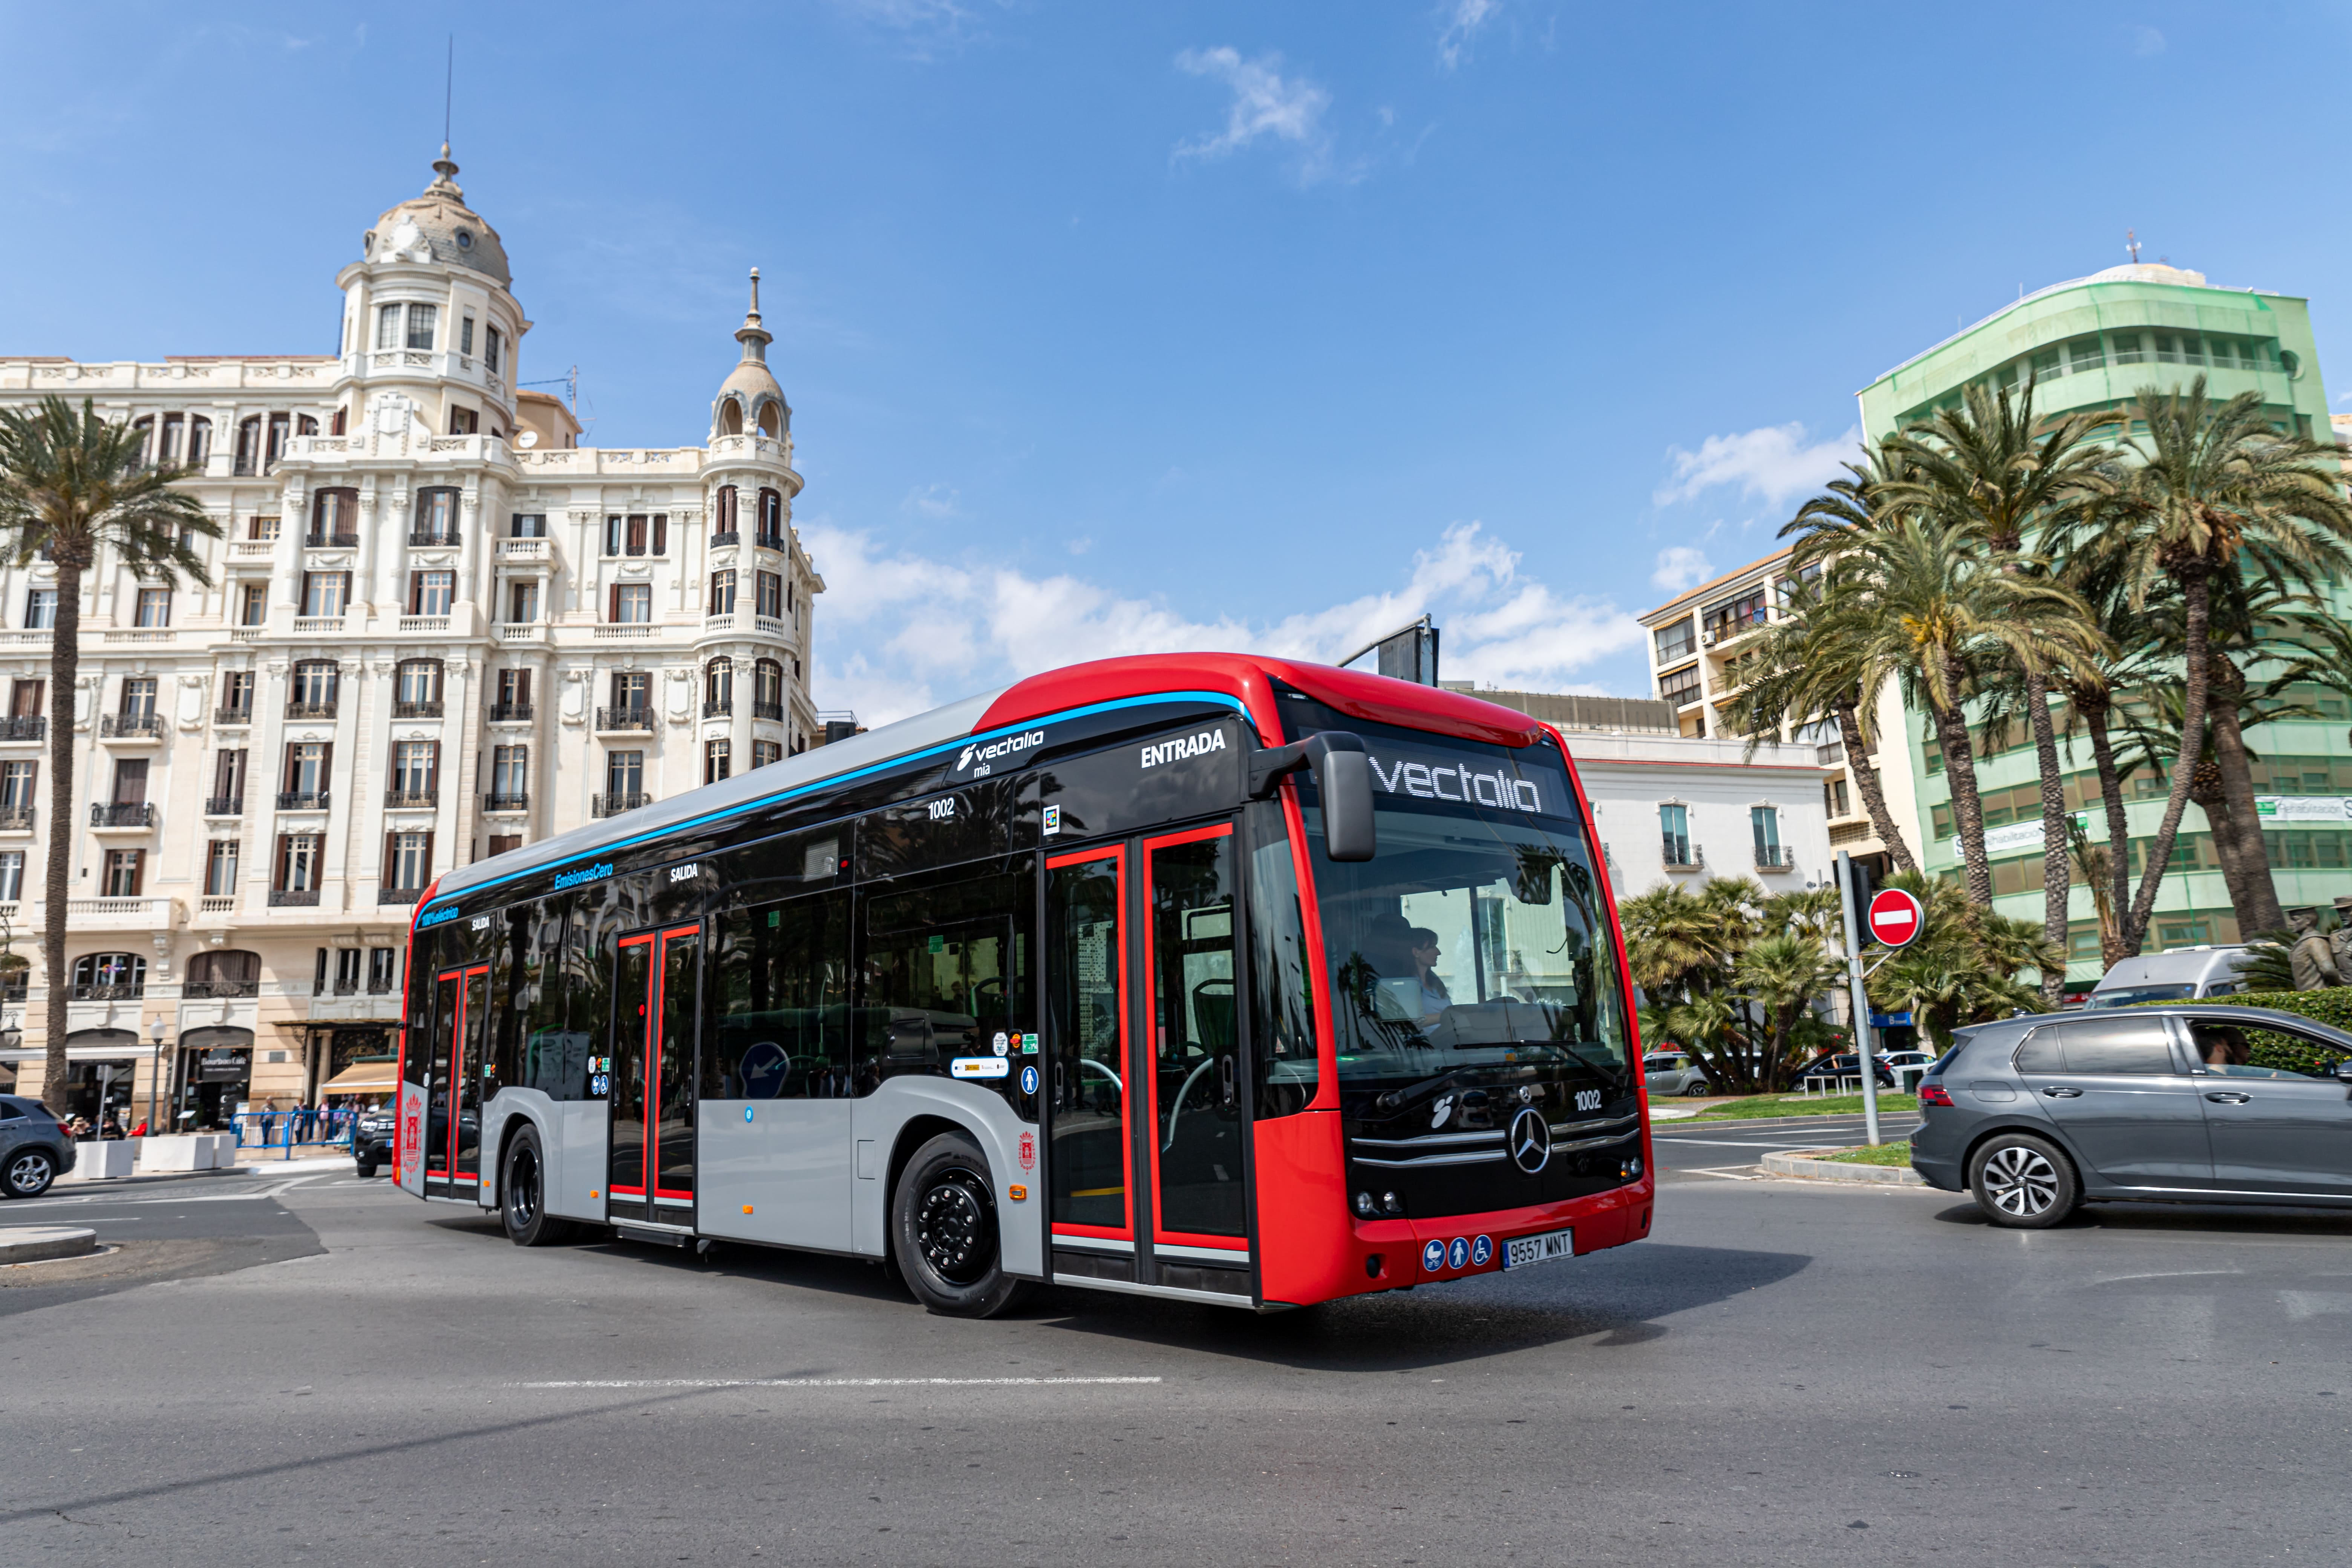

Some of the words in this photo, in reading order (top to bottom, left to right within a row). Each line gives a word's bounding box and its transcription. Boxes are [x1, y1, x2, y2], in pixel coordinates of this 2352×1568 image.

[975, 730, 1044, 761] vectalia
[1141, 729, 1226, 768] ENTRADA
[974, 763, 990, 778] mia
[1369, 757, 1541, 812] vectalia
[928, 797, 954, 820] 1002
[554, 863, 613, 890] EmisionesCero
[671, 863, 698, 882] SALIDA
[472, 916, 490, 931] SALIDA
[1574, 1089, 1602, 1111] 1002
[1511, 1239, 1541, 1263] 9557
[1546, 1234, 1568, 1256] MNT
